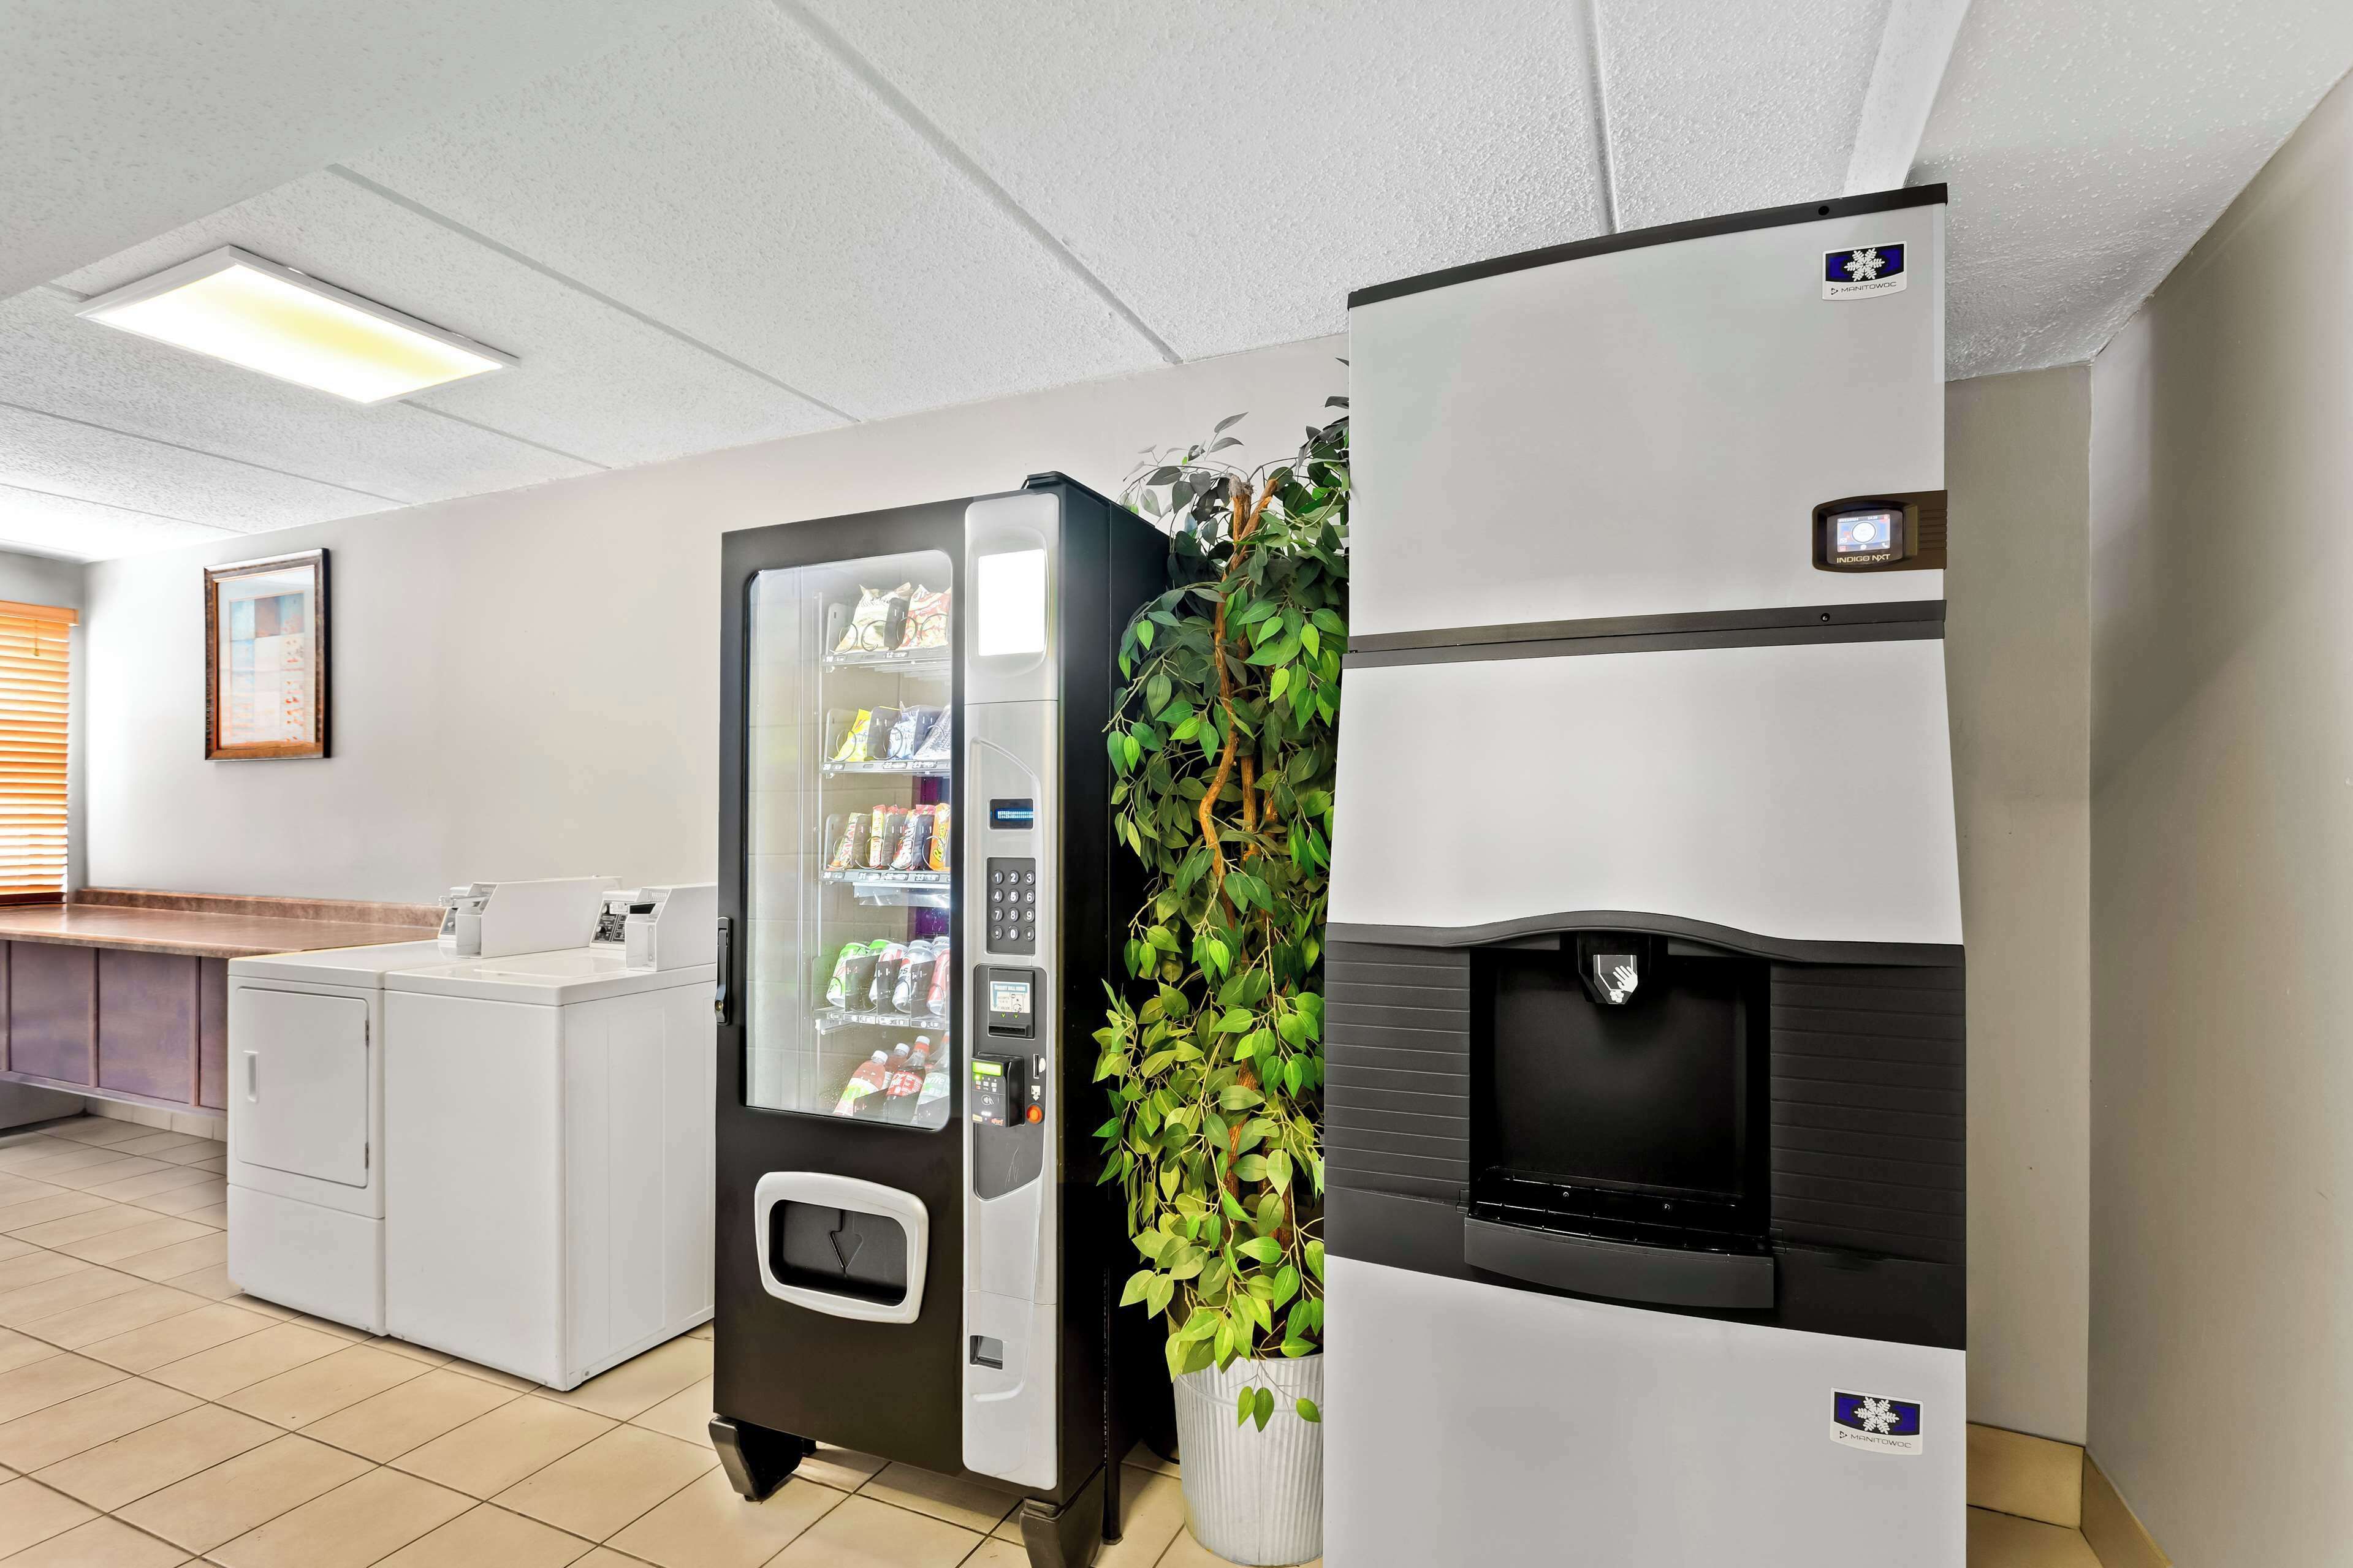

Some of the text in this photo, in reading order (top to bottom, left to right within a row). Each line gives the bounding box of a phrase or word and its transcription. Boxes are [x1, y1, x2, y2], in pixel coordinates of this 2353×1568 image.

[1841, 282, 1896, 292] MANITOWOC
[995, 873, 1032, 883] 1 2 3
[994, 891, 1032, 902] 4 5 6
[995, 910, 1032, 920] 7 8 9
[1010, 929, 1016, 939] 0
[1850, 1434, 1912, 1448] MANITOWOC
